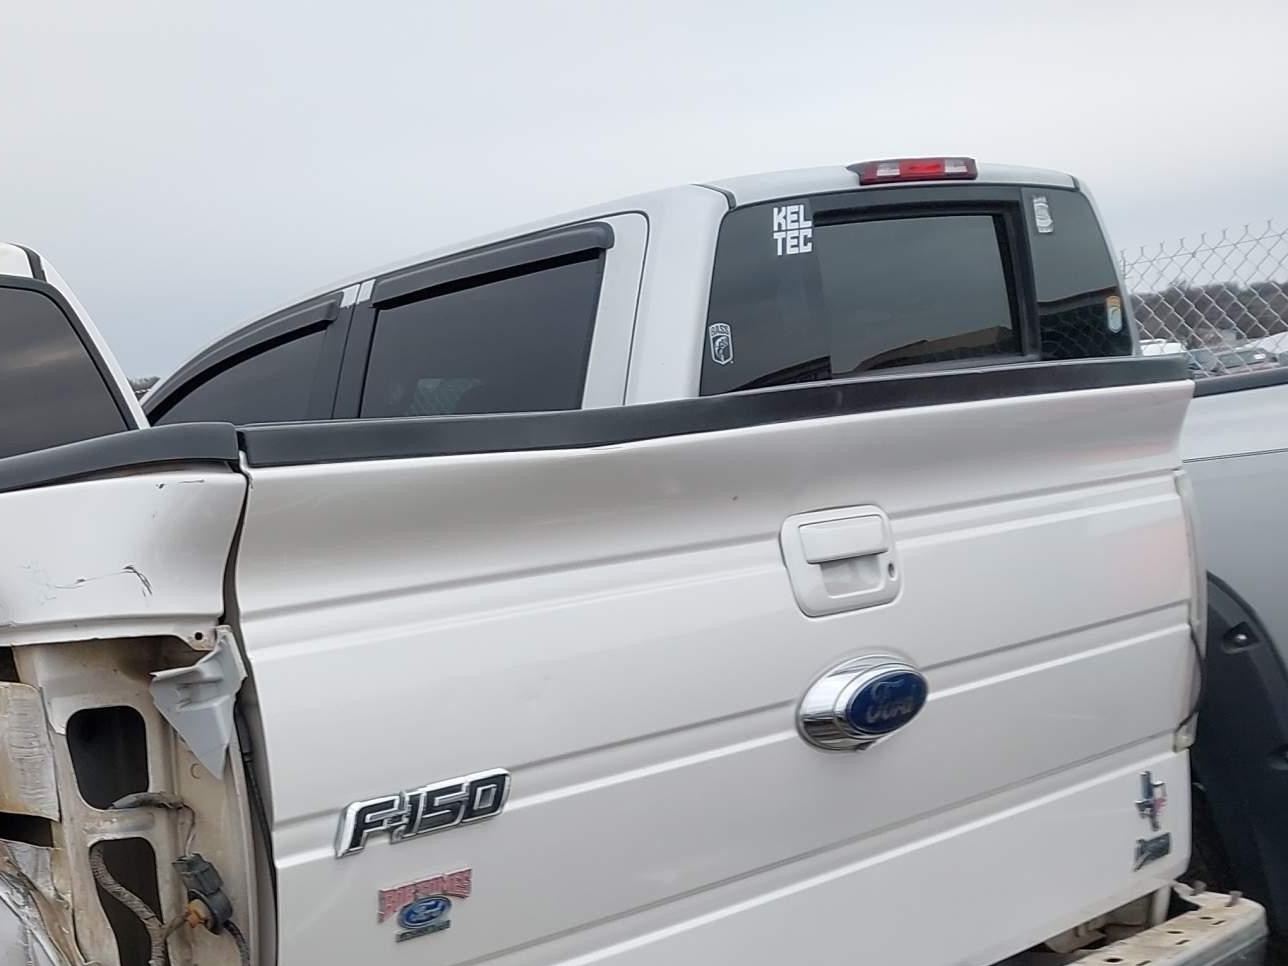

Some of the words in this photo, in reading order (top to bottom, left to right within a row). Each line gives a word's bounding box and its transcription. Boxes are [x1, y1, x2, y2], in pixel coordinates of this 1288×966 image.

[773, 204, 813, 231] KEL
[773, 228, 813, 256] TEC
[334, 767, 512, 859] F-150
